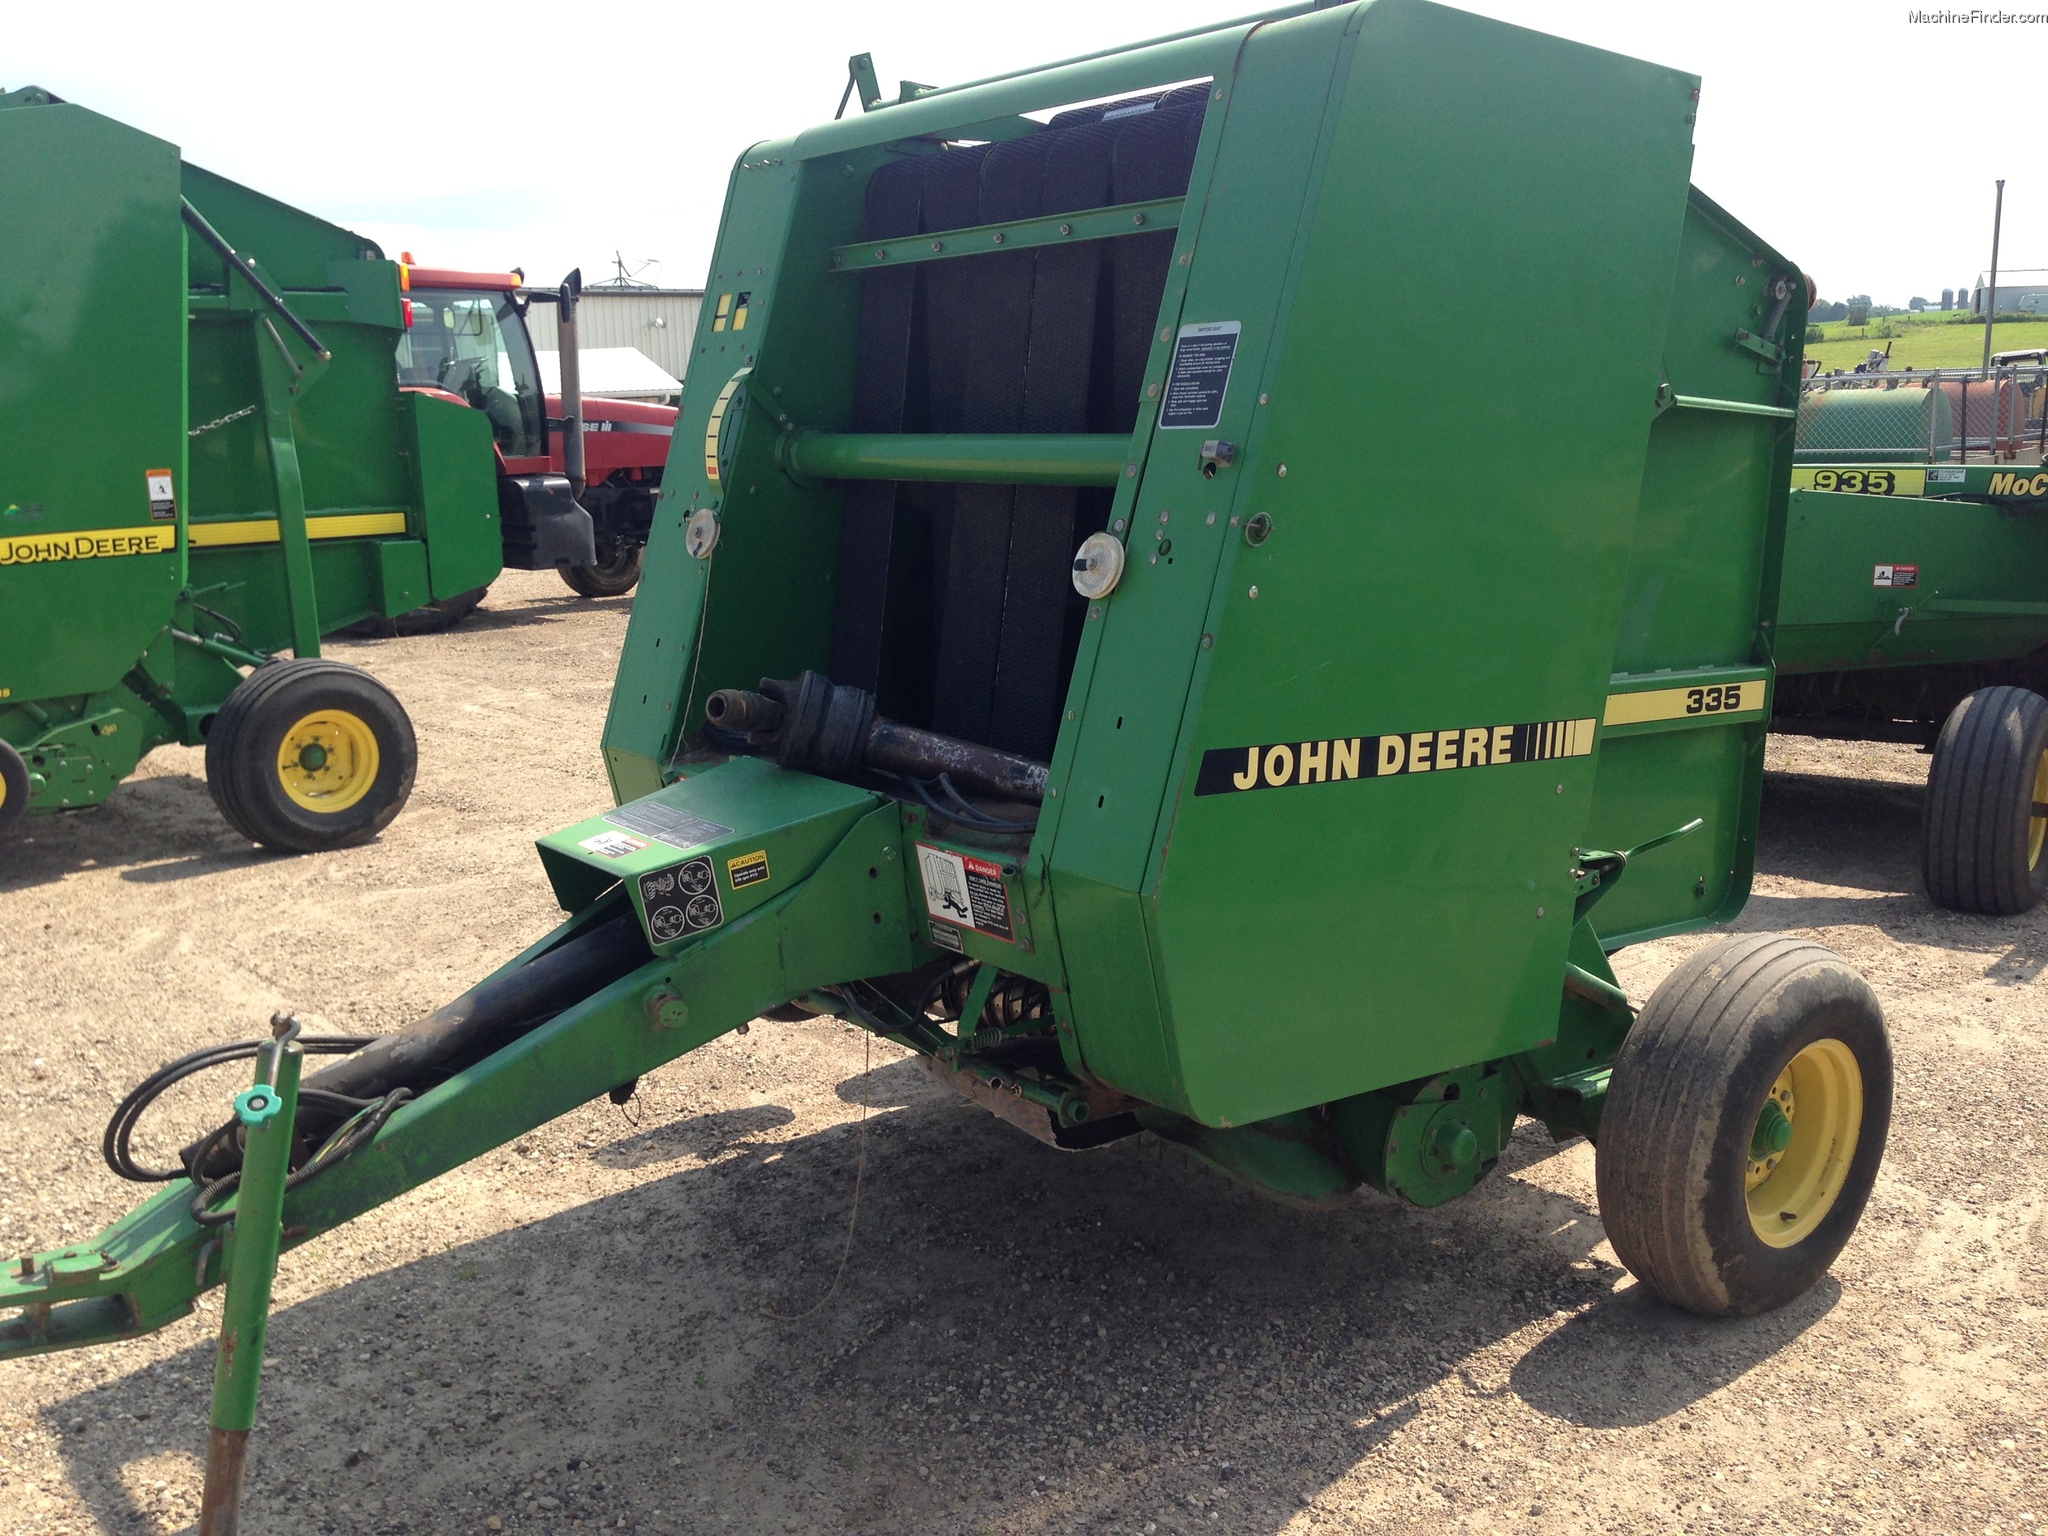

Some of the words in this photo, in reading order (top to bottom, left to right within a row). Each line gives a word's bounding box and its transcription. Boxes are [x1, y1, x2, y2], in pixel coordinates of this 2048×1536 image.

[1815, 470, 1893, 494] 935
[1, 541, 70, 561] JOHN
[75, 535, 160, 556] DEERE
[1686, 684, 1741, 714] 335
[1233, 739, 1360, 790] JOHN
[1377, 725, 1513, 776] DEERE
[736, 854, 764, 867] CAUTION
[975, 864, 997, 876] DANGER
